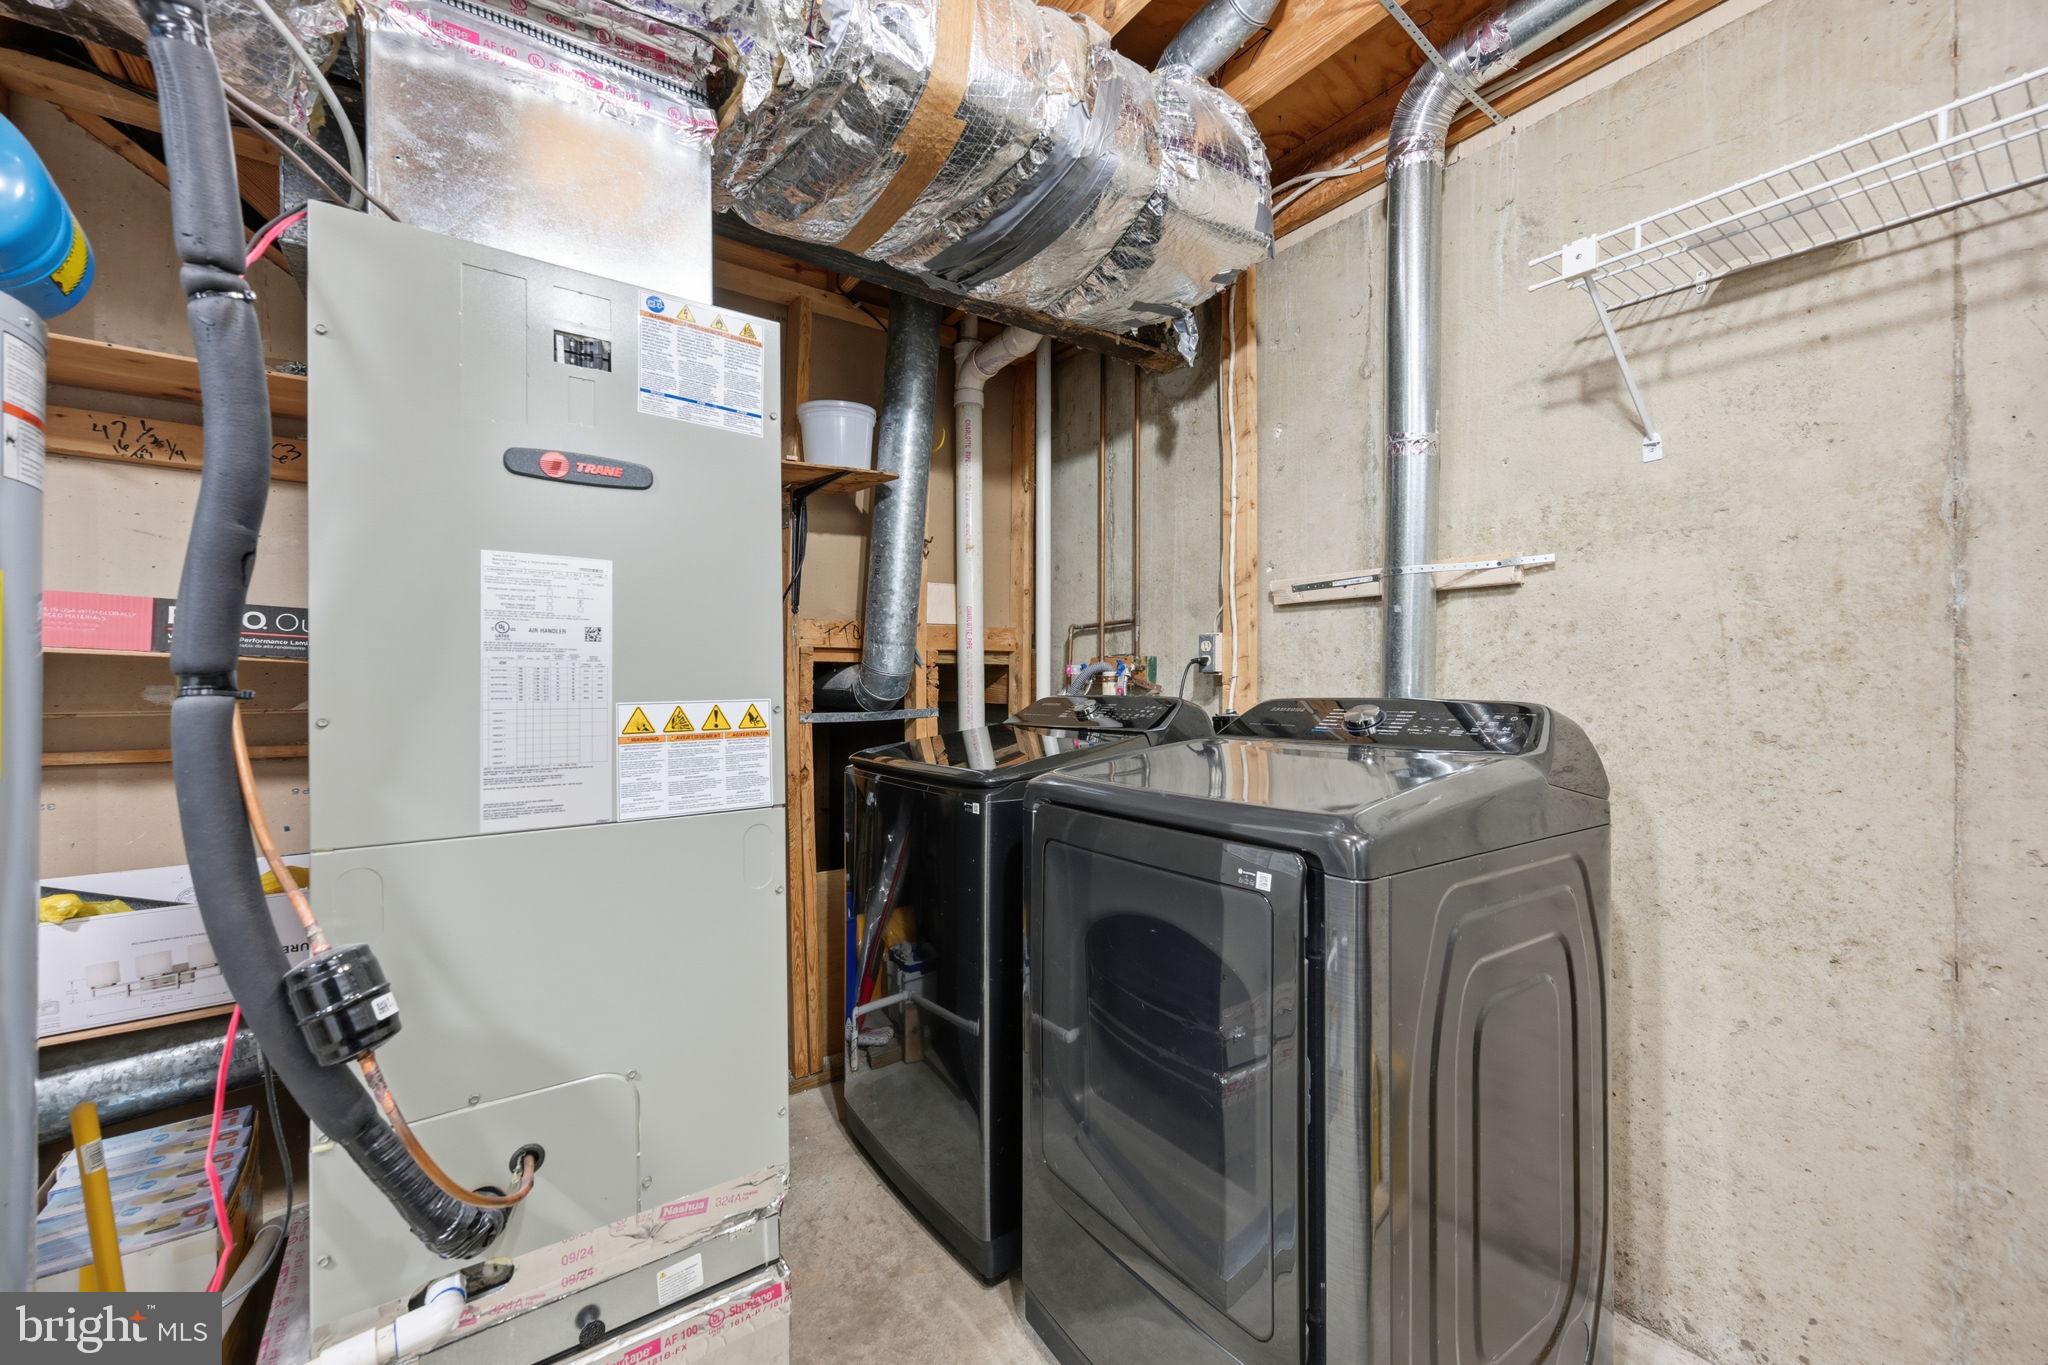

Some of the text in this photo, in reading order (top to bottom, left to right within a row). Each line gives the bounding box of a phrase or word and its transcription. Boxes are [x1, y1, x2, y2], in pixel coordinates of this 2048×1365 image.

[500, 47, 517, 58] 100
[576, 462, 623, 478] TRANE
[663, 1200, 704, 1217] Nashua
[561, 1246, 593, 1266] 09/24
[664, 1335, 678, 1348] AF
[682, 1327, 698, 1340] 100
